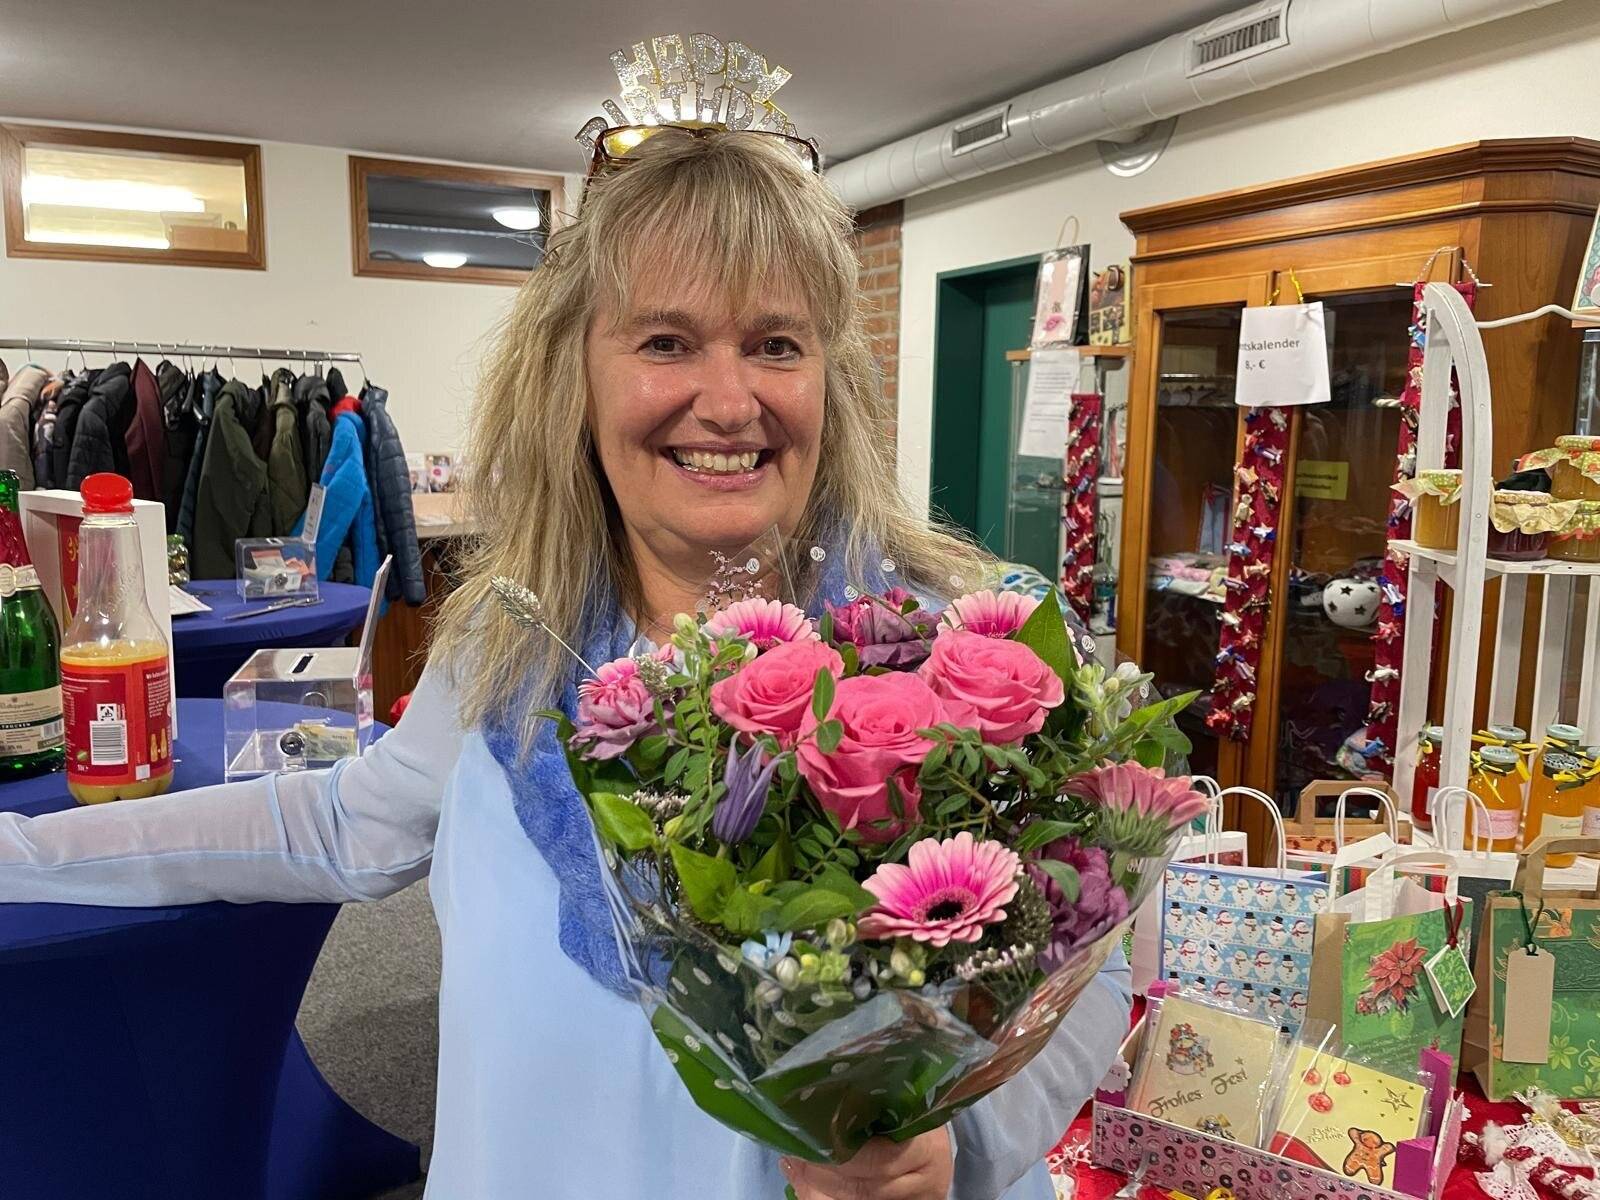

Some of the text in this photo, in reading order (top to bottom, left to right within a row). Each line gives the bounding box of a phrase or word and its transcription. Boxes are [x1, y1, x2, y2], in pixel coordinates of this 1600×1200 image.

[609, 33, 793, 105] HAPPY
[1258, 360, 1266, 369] €
[1147, 1067, 1248, 1118] Frohes Fest
